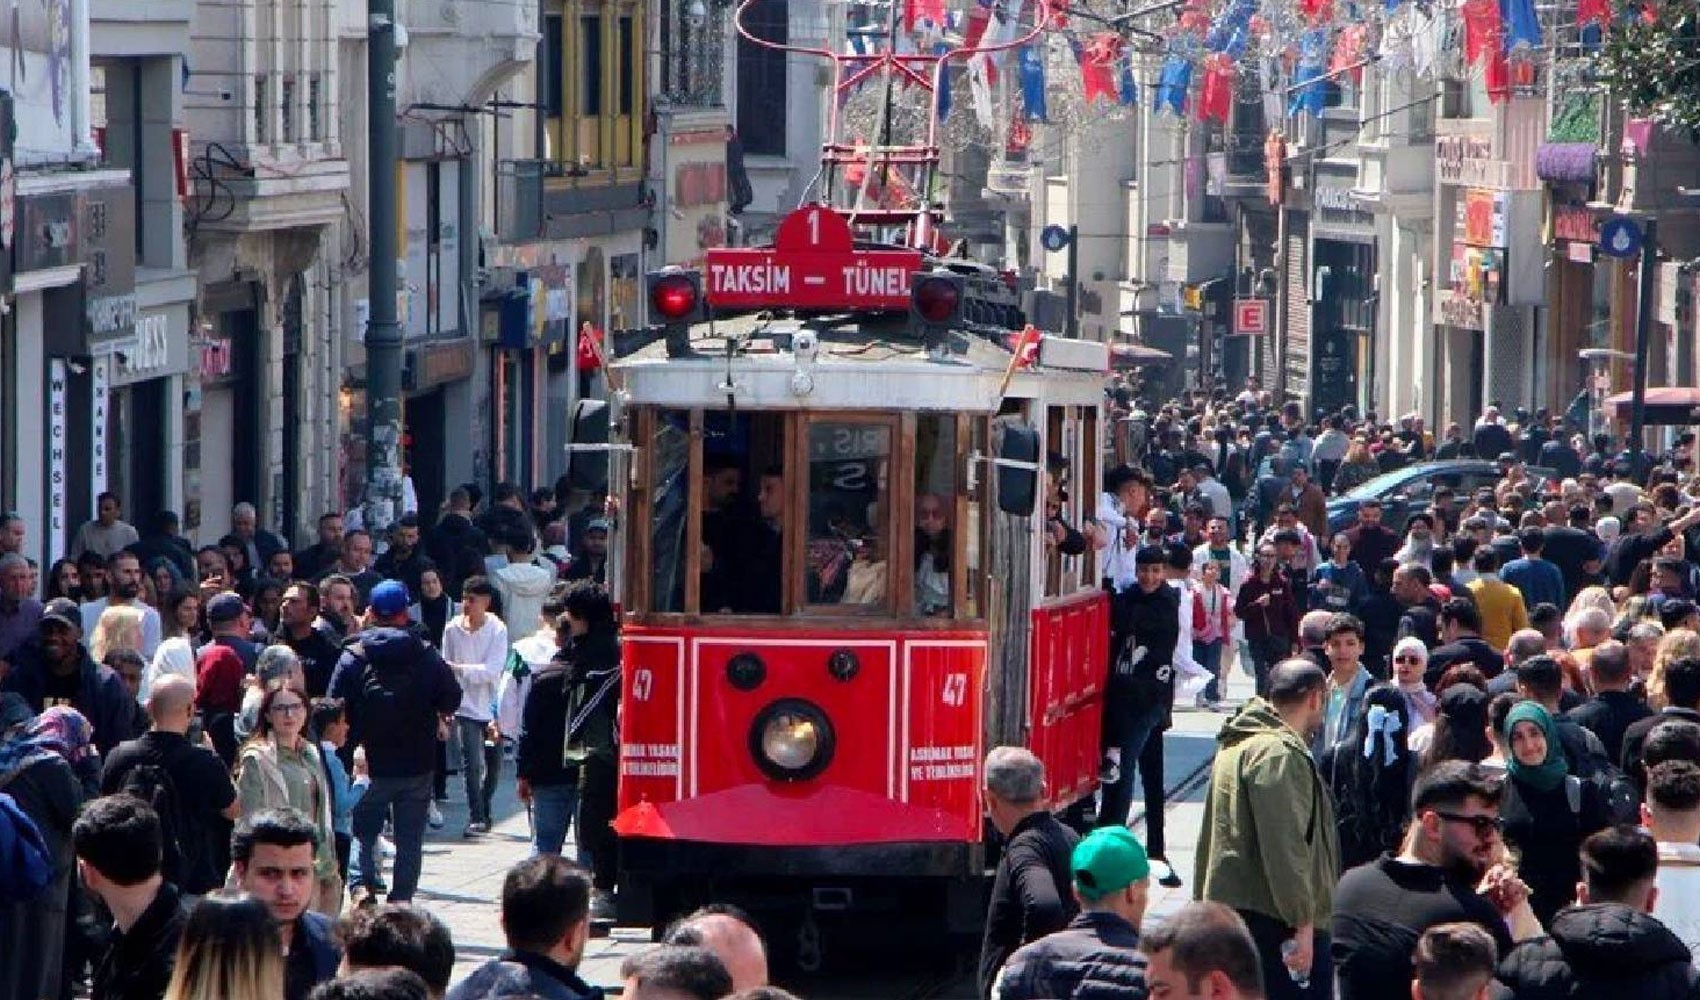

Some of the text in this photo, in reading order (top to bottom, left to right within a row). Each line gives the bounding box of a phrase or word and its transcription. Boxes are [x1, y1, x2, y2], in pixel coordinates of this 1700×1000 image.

[807, 210, 820, 244] 1
[711, 257, 790, 294] TAKSİM
[842, 259, 911, 296] TÜNEL
[1243, 308, 1261, 327] E
[95, 367, 104, 476] CHANGE
[53, 380, 63, 530] WECHSEL
[632, 669, 652, 701] 47
[942, 673, 967, 707] 47
